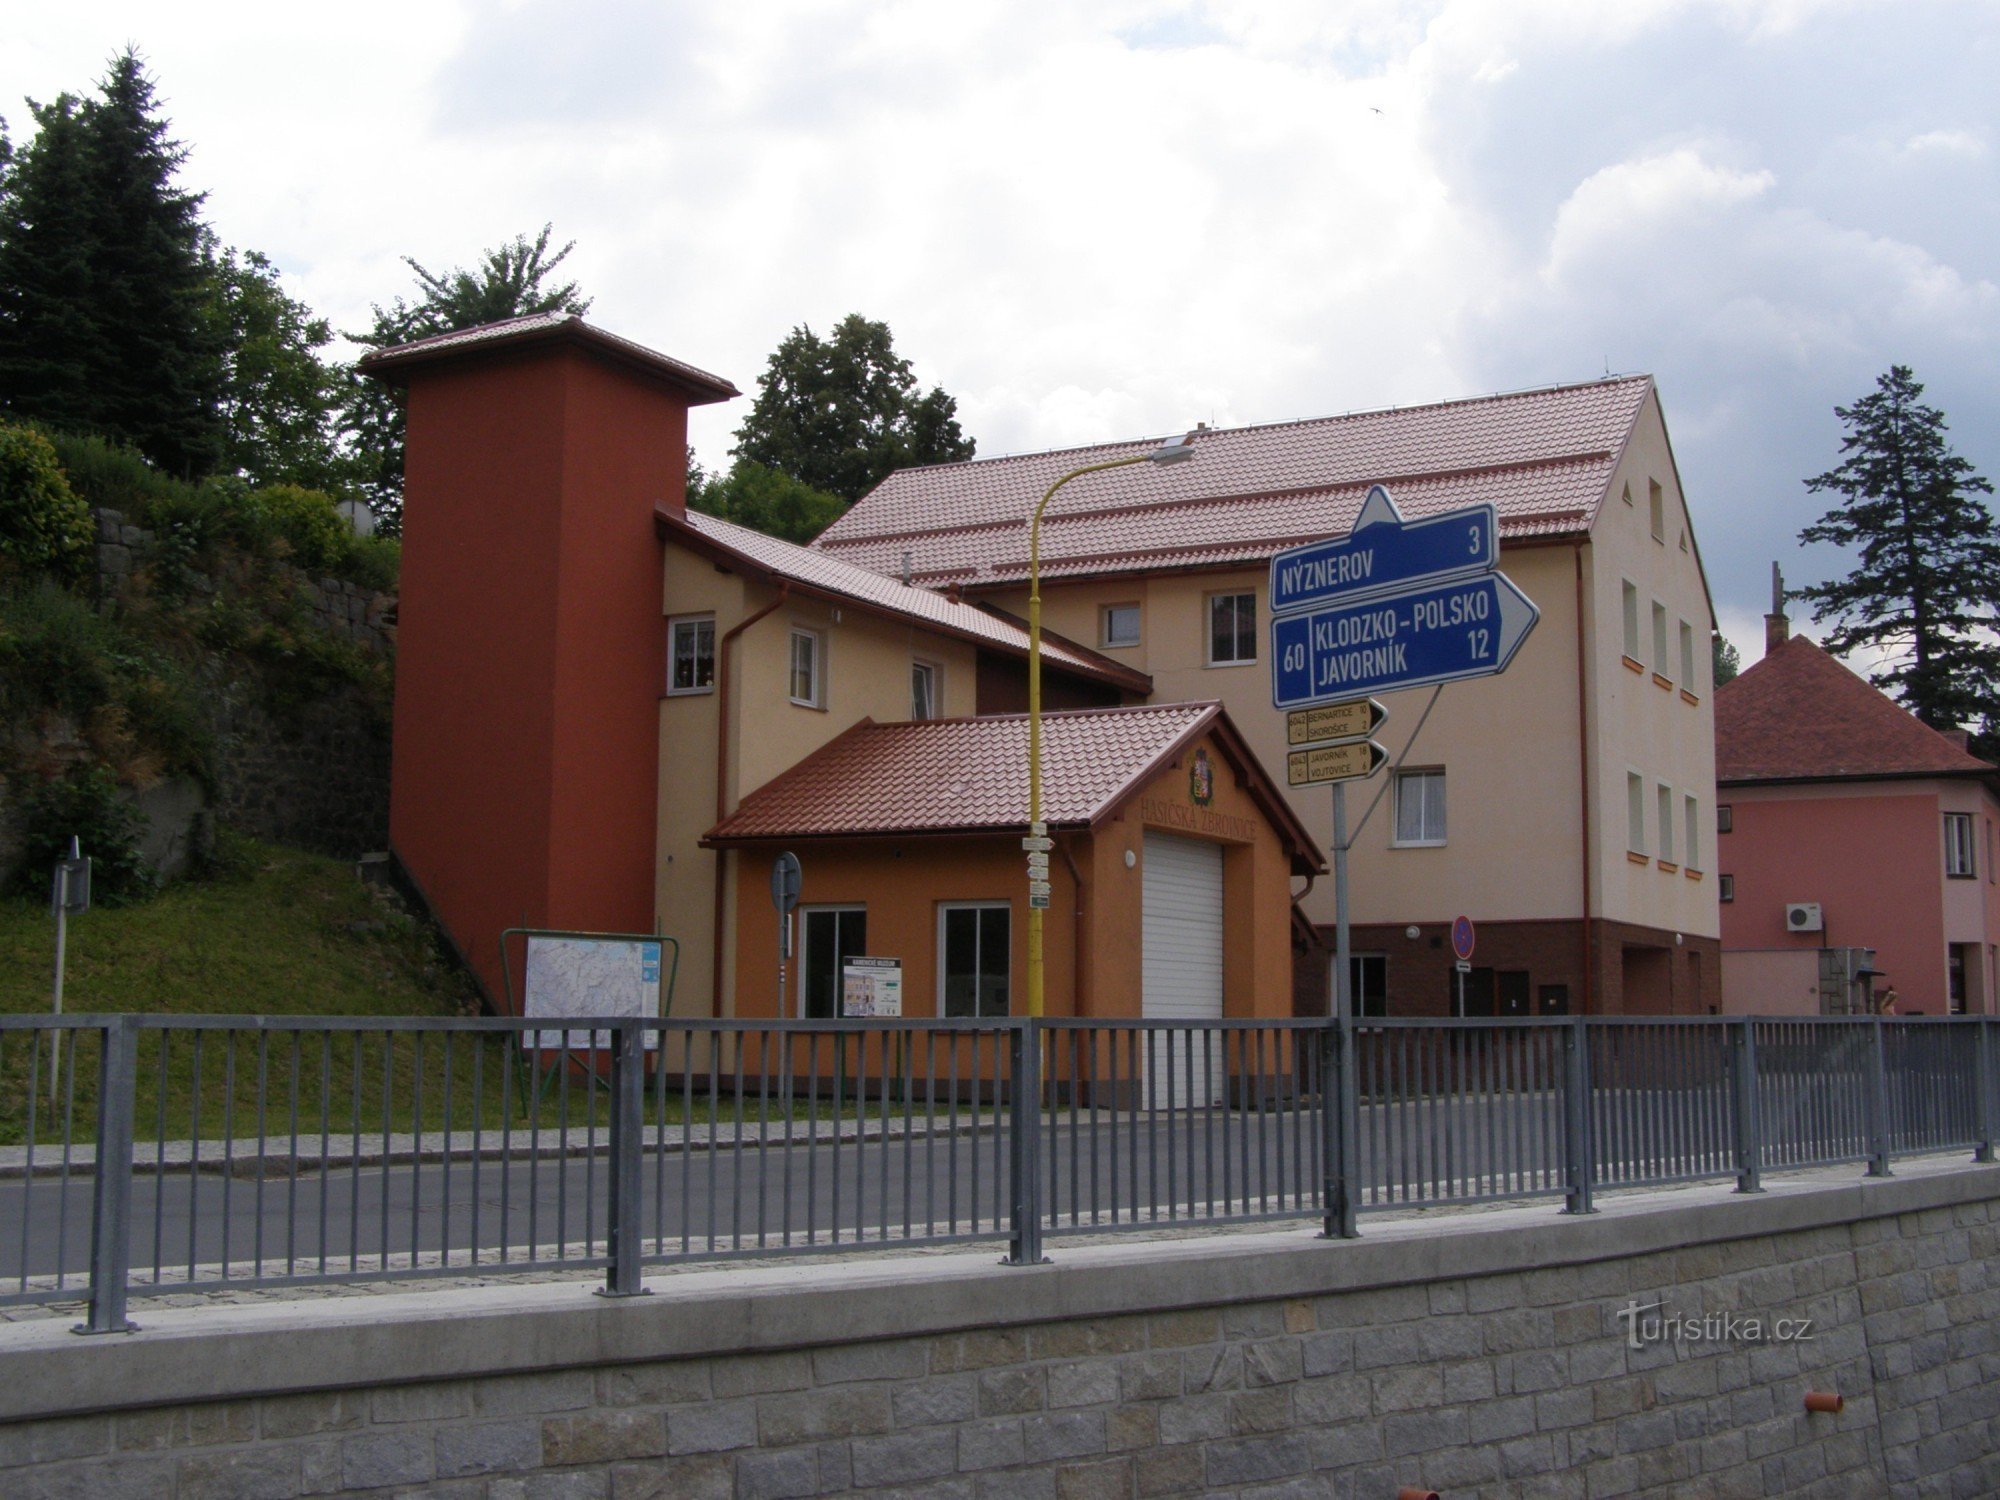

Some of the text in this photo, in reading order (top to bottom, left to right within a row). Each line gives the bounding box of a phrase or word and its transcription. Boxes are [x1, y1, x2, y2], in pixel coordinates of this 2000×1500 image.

[1281, 525, 1481, 597] NÝZNEROV 3
[1283, 643, 1305, 673] 60
[1318, 628, 1490, 687] JAVORNÍK 12
[1308, 707, 1353, 723] BERNARTICE
[1308, 720, 1367, 738] SKOROŠICE 2
[1310, 747, 1349, 763] JAVORNÍK
[1311, 763, 1351, 778] VOJTOVICE
[1140, 798, 1197, 830] HASIČSKÁ
